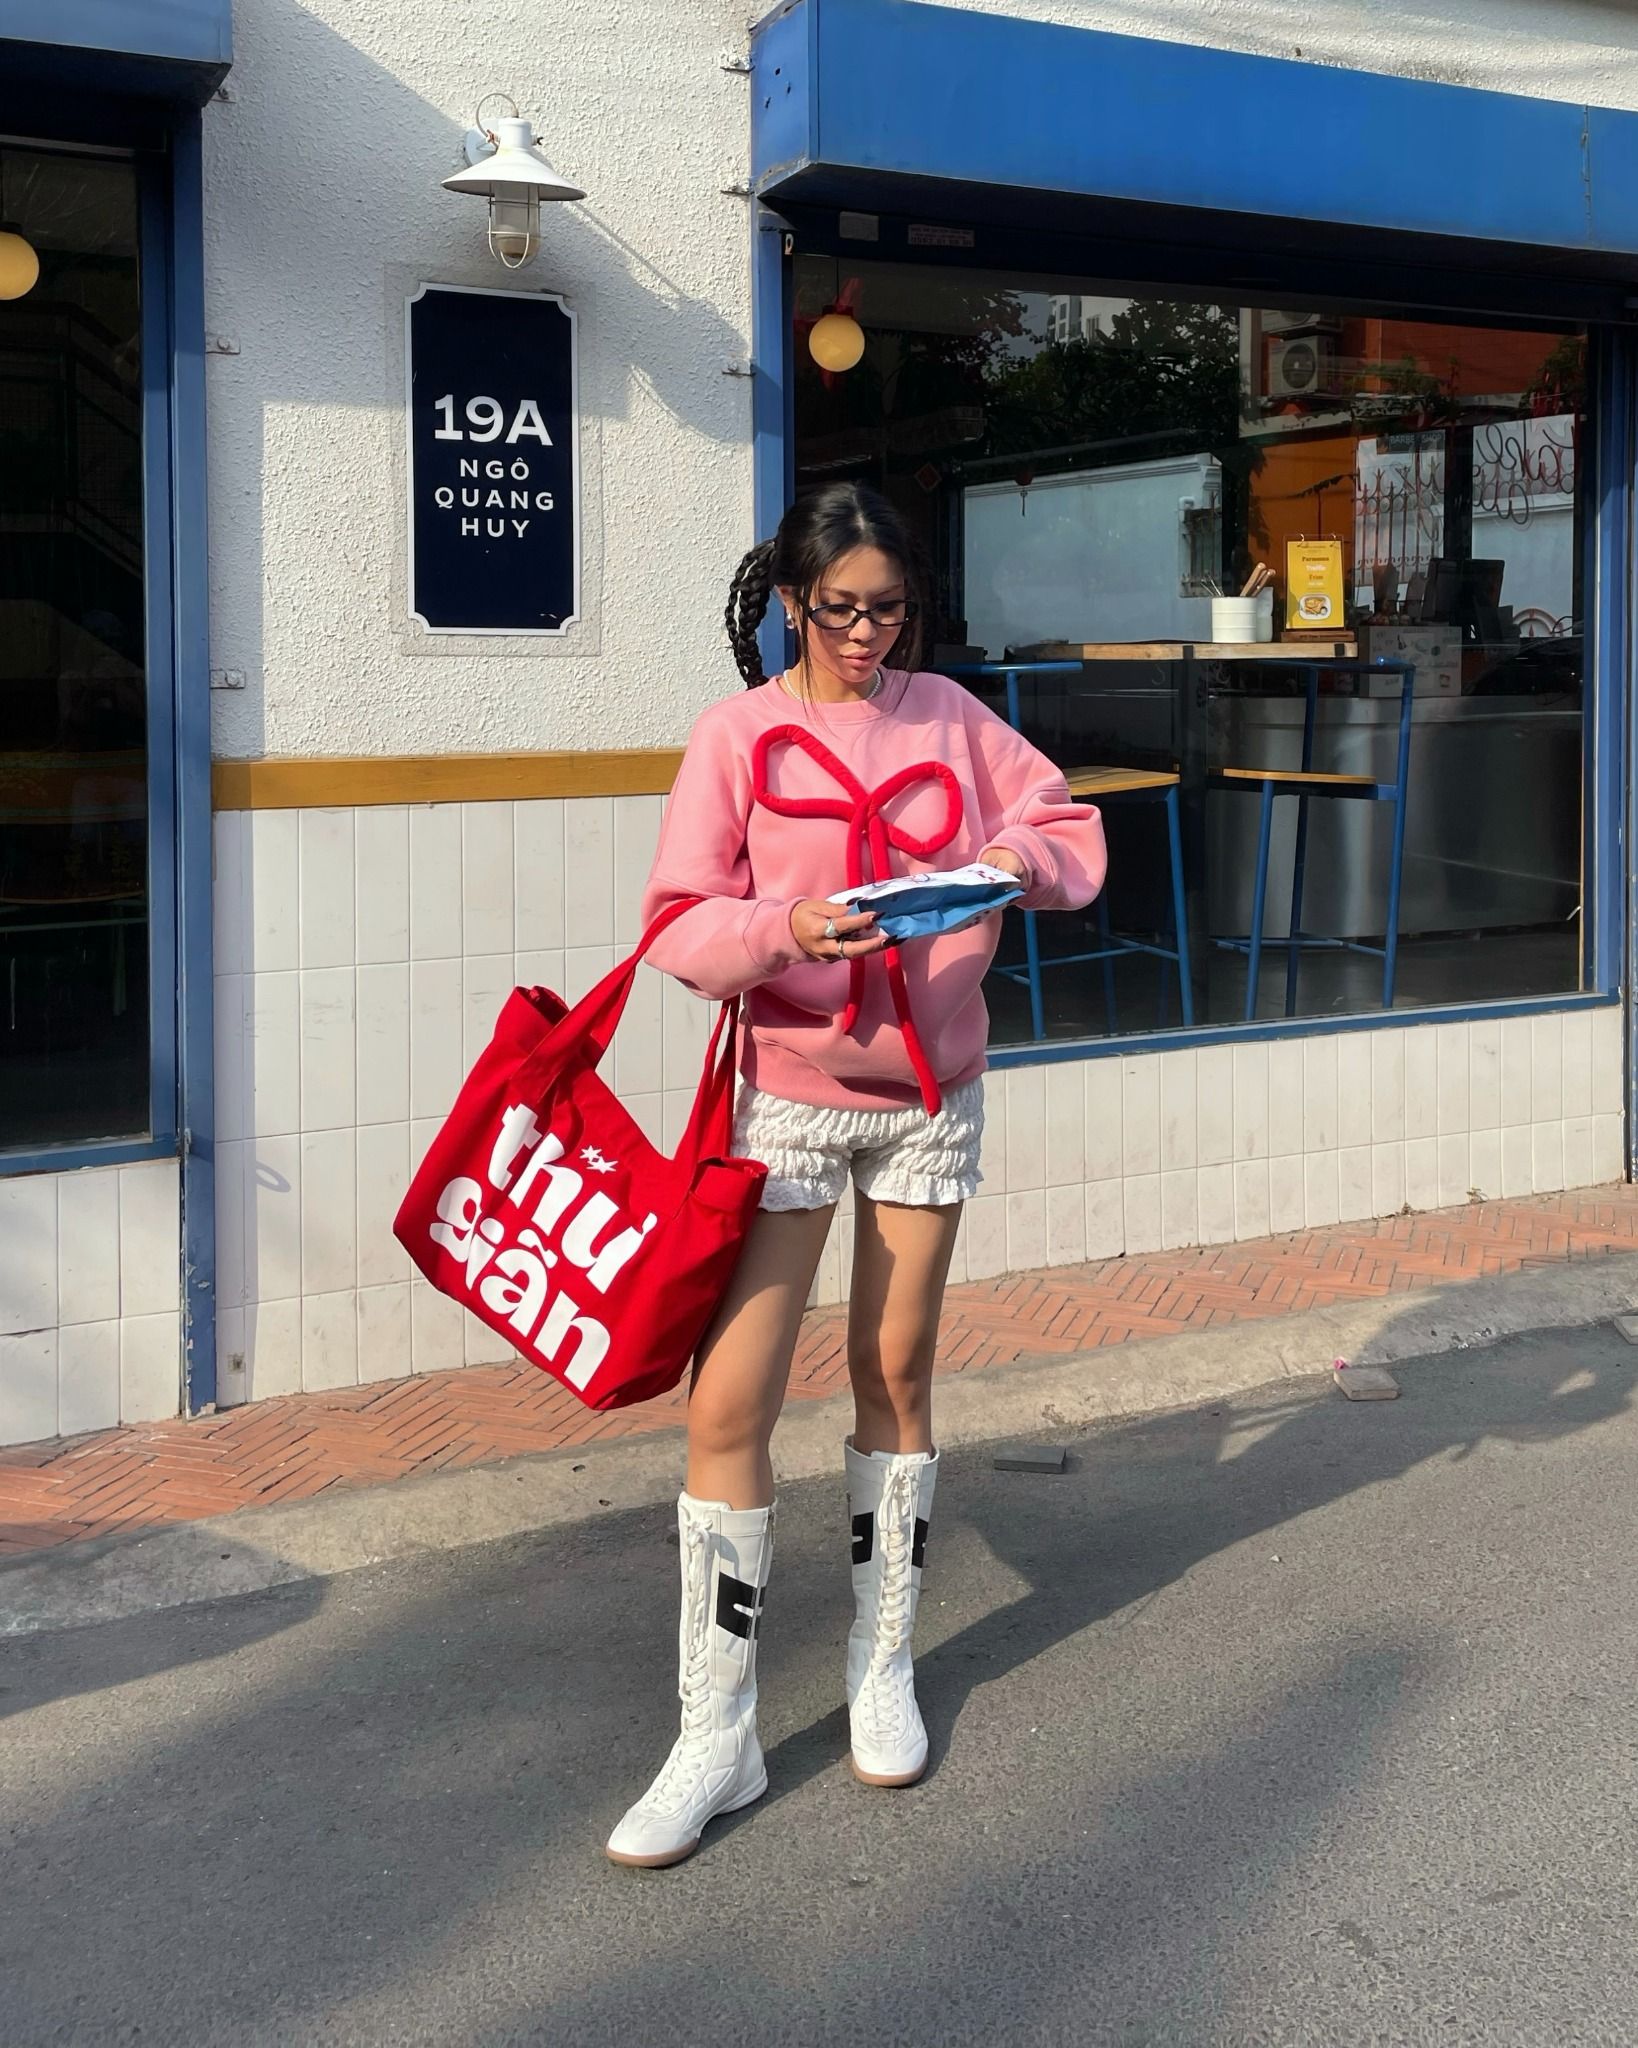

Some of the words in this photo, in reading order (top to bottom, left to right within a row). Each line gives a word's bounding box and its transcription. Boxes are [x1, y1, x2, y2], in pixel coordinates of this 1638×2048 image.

[434, 393, 553, 446] 19A
[1390, 434, 1415, 445] BARBE
[460, 456, 530, 480] NGÔ
[434, 486, 554, 511] QUANG
[461, 517, 530, 538] HUY
[488, 1103, 658, 1294] thư
[429, 1176, 611, 1392] giãn
